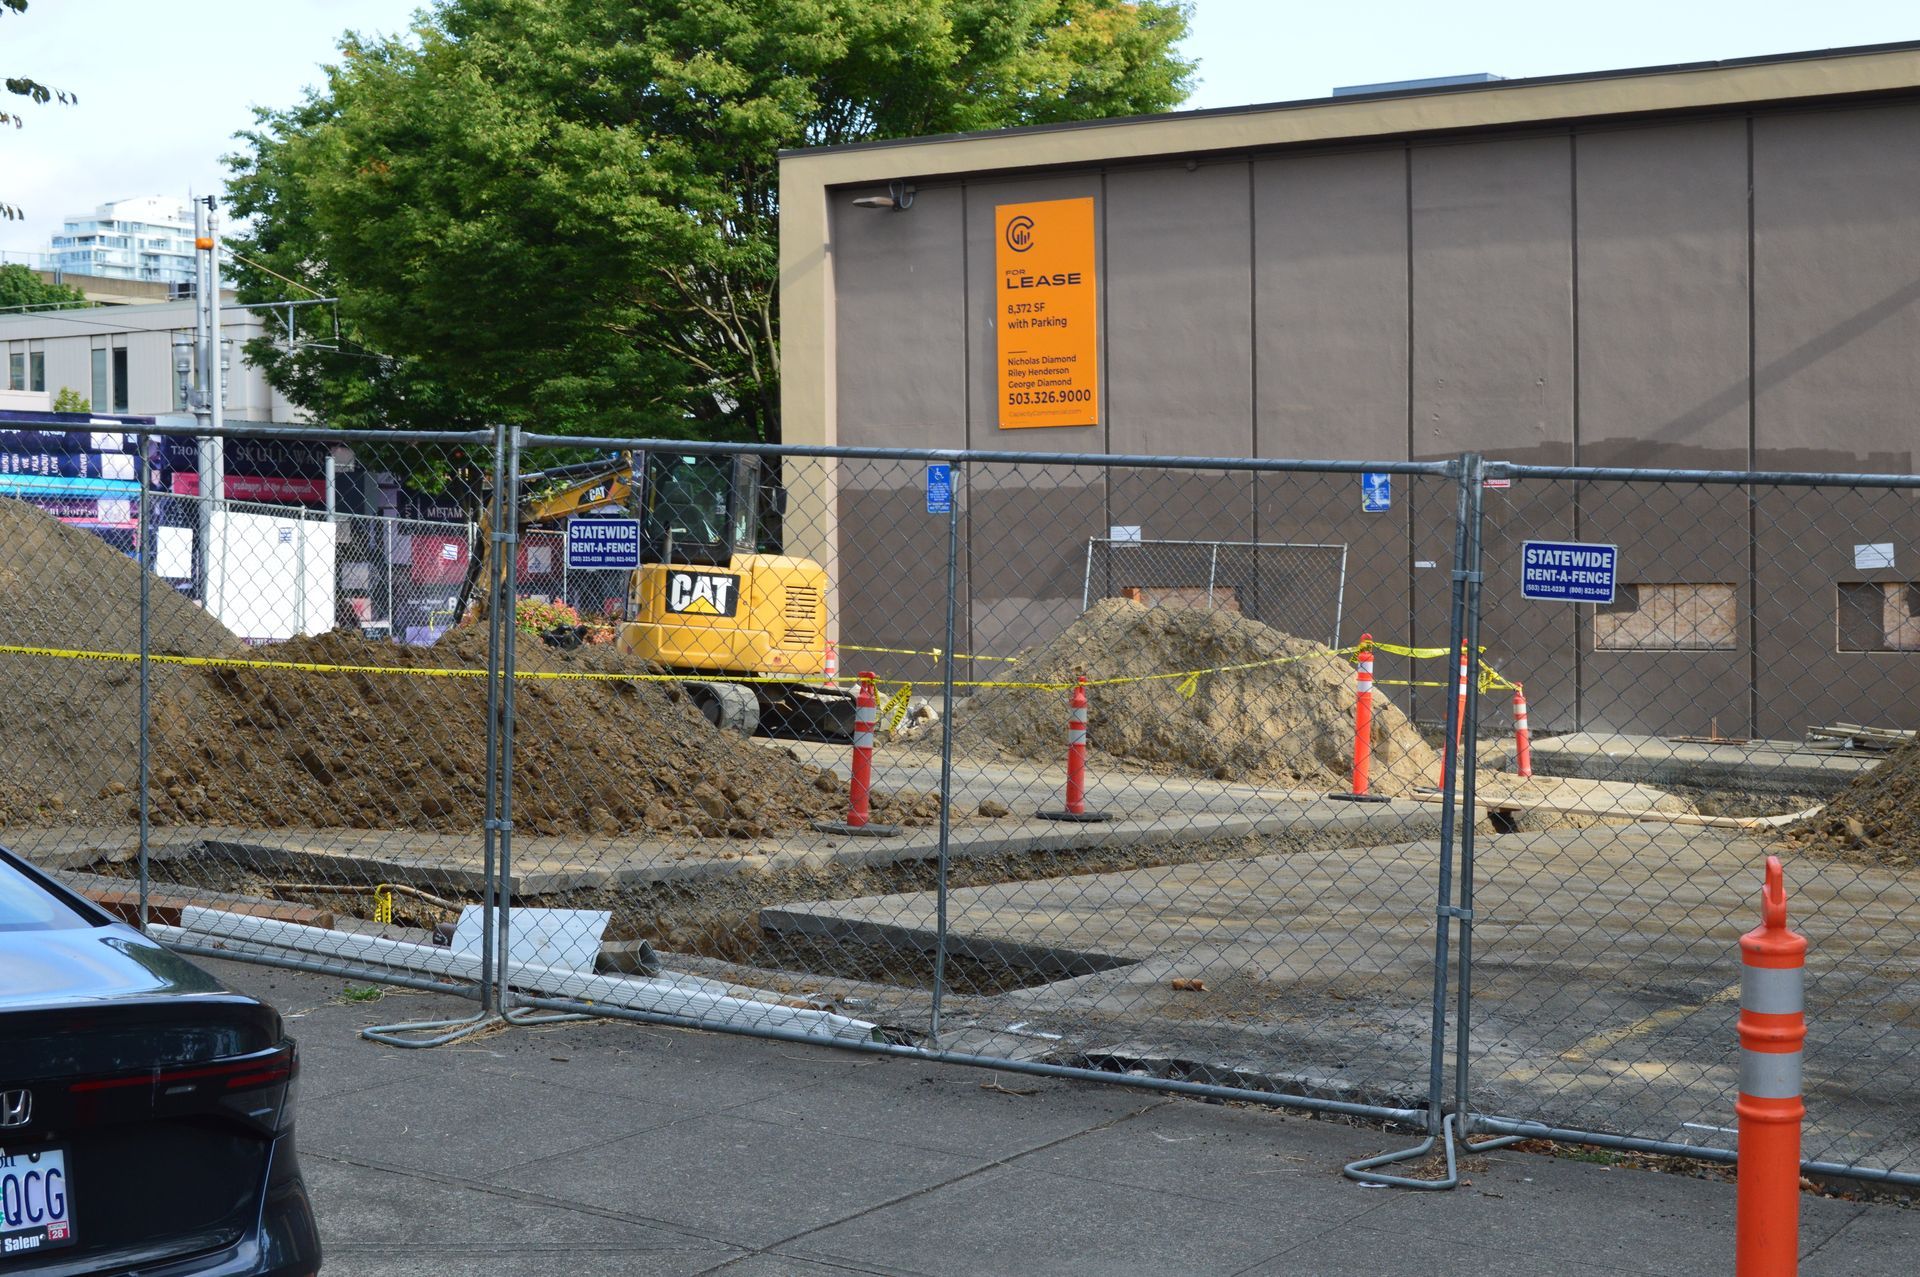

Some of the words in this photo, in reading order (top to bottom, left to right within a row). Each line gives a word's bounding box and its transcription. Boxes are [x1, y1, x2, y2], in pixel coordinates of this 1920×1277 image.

[1007, 273, 1081, 289] LEASE
[1008, 303, 1031, 315] 8,372
[1034, 302, 1045, 312] SF
[1008, 319, 1028, 330] with
[1031, 316, 1067, 329] Parking
[1008, 357, 1039, 366] Nicholas
[1042, 355, 1076, 364] Diamond
[1008, 370, 1026, 379] Riley
[1028, 367, 1069, 376] Henderson
[1008, 380, 1035, 390] George
[1037, 378, 1072, 387] Diamond
[1008, 389, 1092, 406] 503.326.9000
[589, 486, 605, 501] CAT
[61, 505, 97, 516] Morriso
[571, 526, 637, 539] STATEWIDE
[571, 542, 636, 553] RENT-A-FENCE
[1527, 549, 1612, 568] STATEWIDE
[1527, 569, 1611, 585] RENT-A-FENCE
[671, 573, 732, 614] CAT
[2, 1168, 65, 1227] QCG
[52, 1230, 64, 1240] 28
[4, 1236, 40, 1252] Salem
